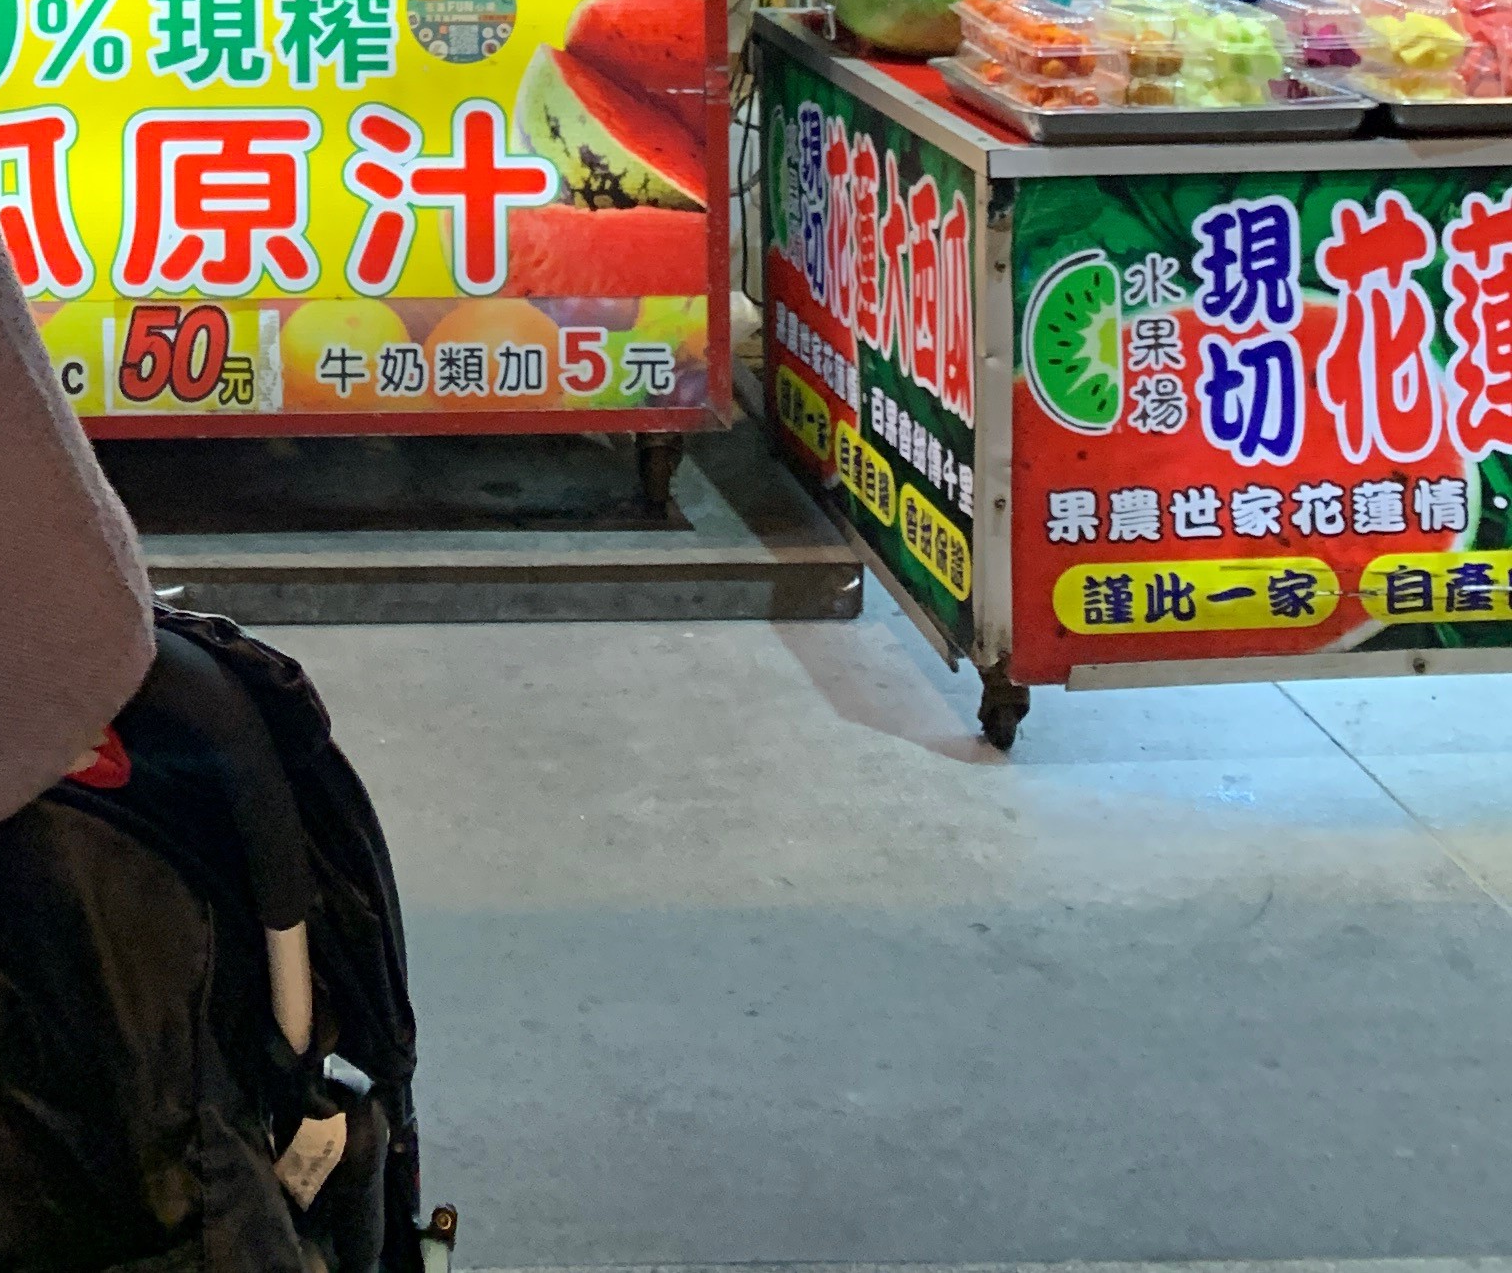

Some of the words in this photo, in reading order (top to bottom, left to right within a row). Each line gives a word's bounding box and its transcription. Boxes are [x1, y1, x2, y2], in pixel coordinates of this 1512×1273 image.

[320, 330, 676, 396] 牛奶類加5元
[1200, 204, 1298, 460] 現切
[1083, 570, 1319, 626] 謹此一家
[1385, 562, 1512, 618] 自產
